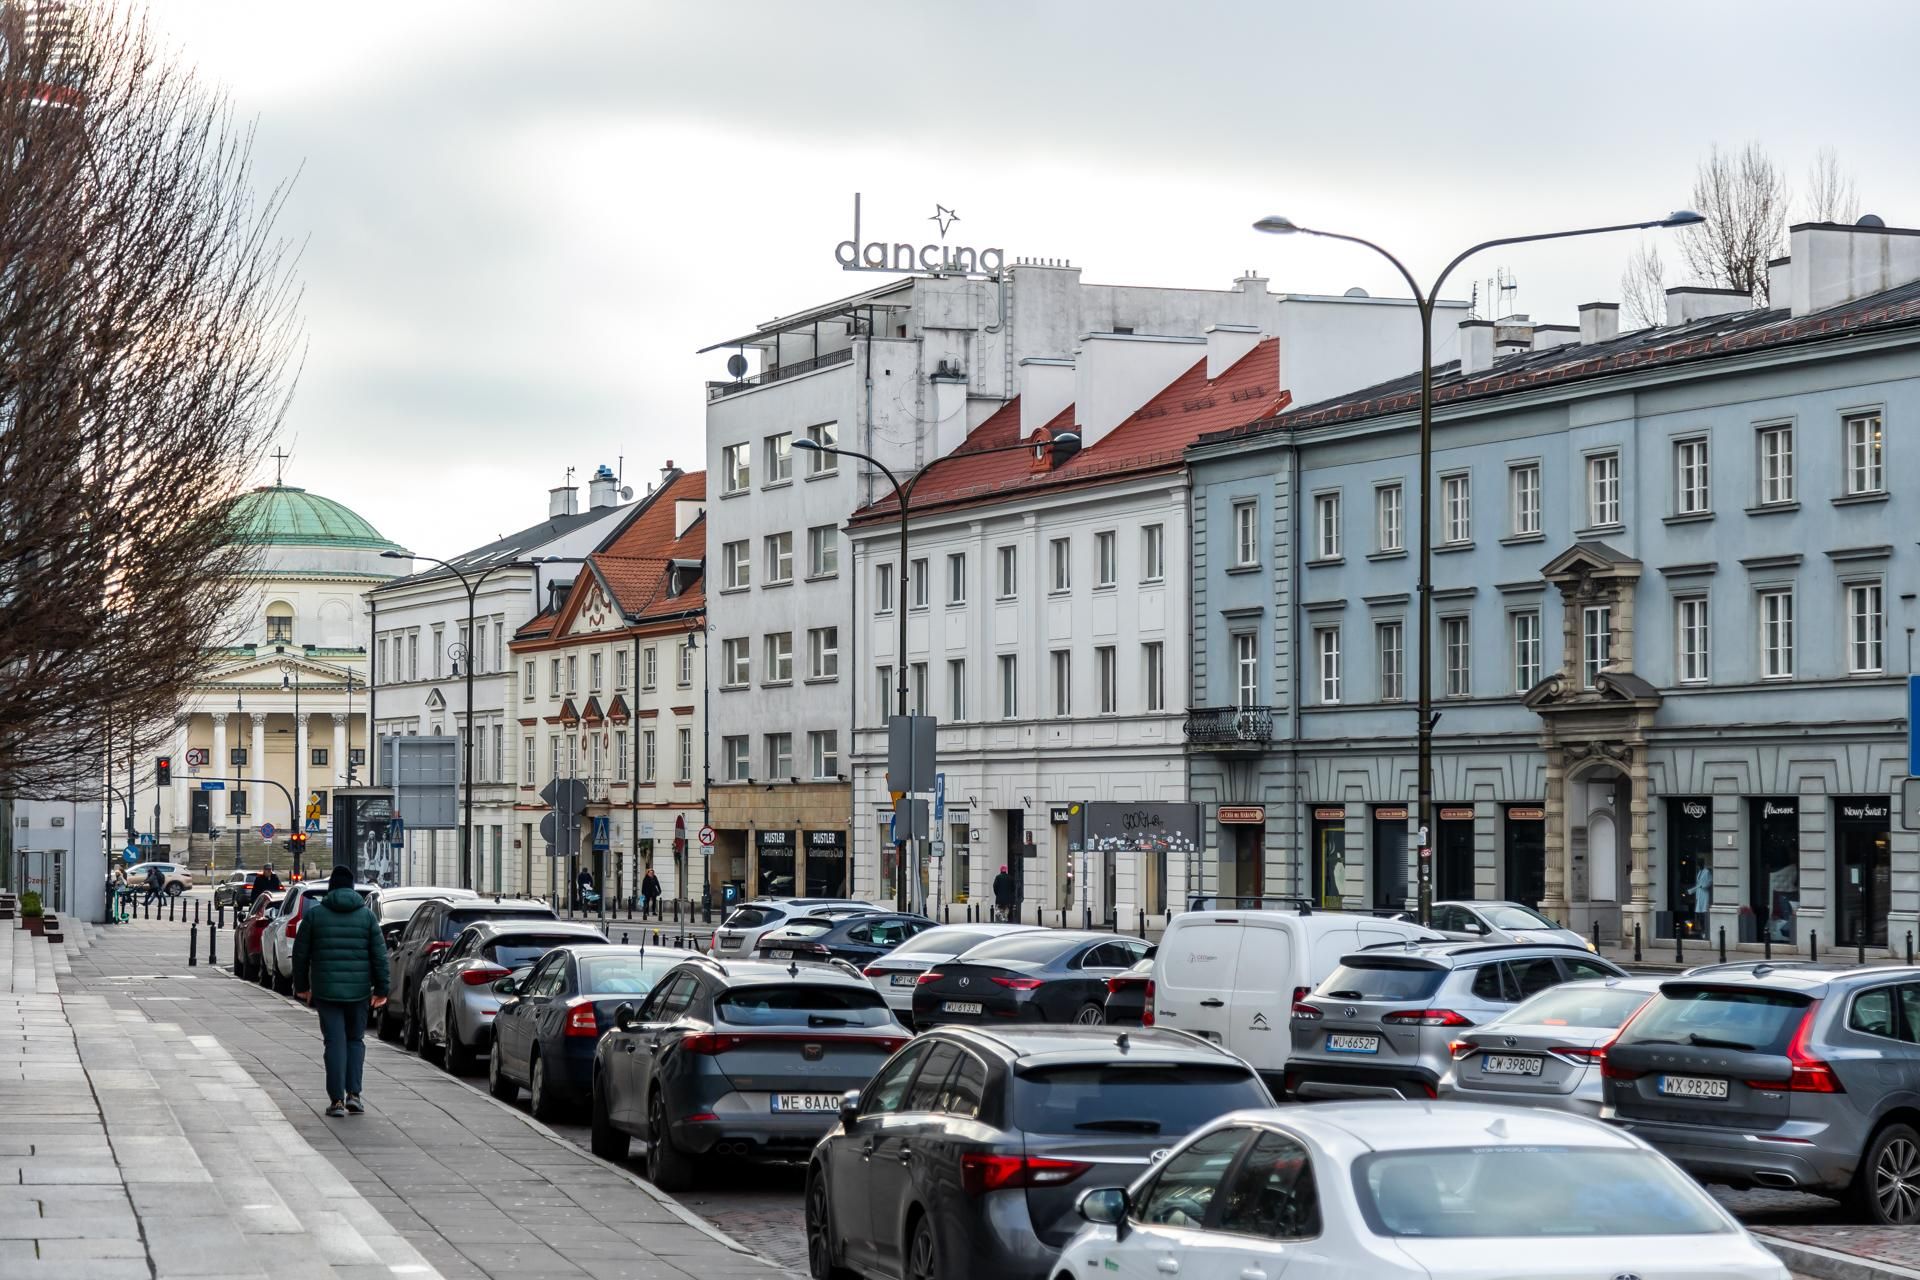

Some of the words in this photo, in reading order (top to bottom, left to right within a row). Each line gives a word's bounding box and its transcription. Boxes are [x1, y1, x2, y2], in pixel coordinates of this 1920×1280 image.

[835, 192, 1004, 288] dancing
[1682, 802, 1707, 817] VOSSEN
[1844, 806, 1864, 819] Nowy
[1882, 808, 1887, 816] 7
[764, 832, 785, 843] HUSTLER
[813, 832, 836, 844] HUSTLER
[726, 888, 734, 899] P
[1333, 1036, 1345, 1049] WU
[1347, 1036, 1377, 1050] 6652P
[1489, 1056, 1504, 1070] CW
[1666, 1078, 1684, 1093] WX
[1687, 1080, 1727, 1096] 98205
[780, 1096, 800, 1109] WE
